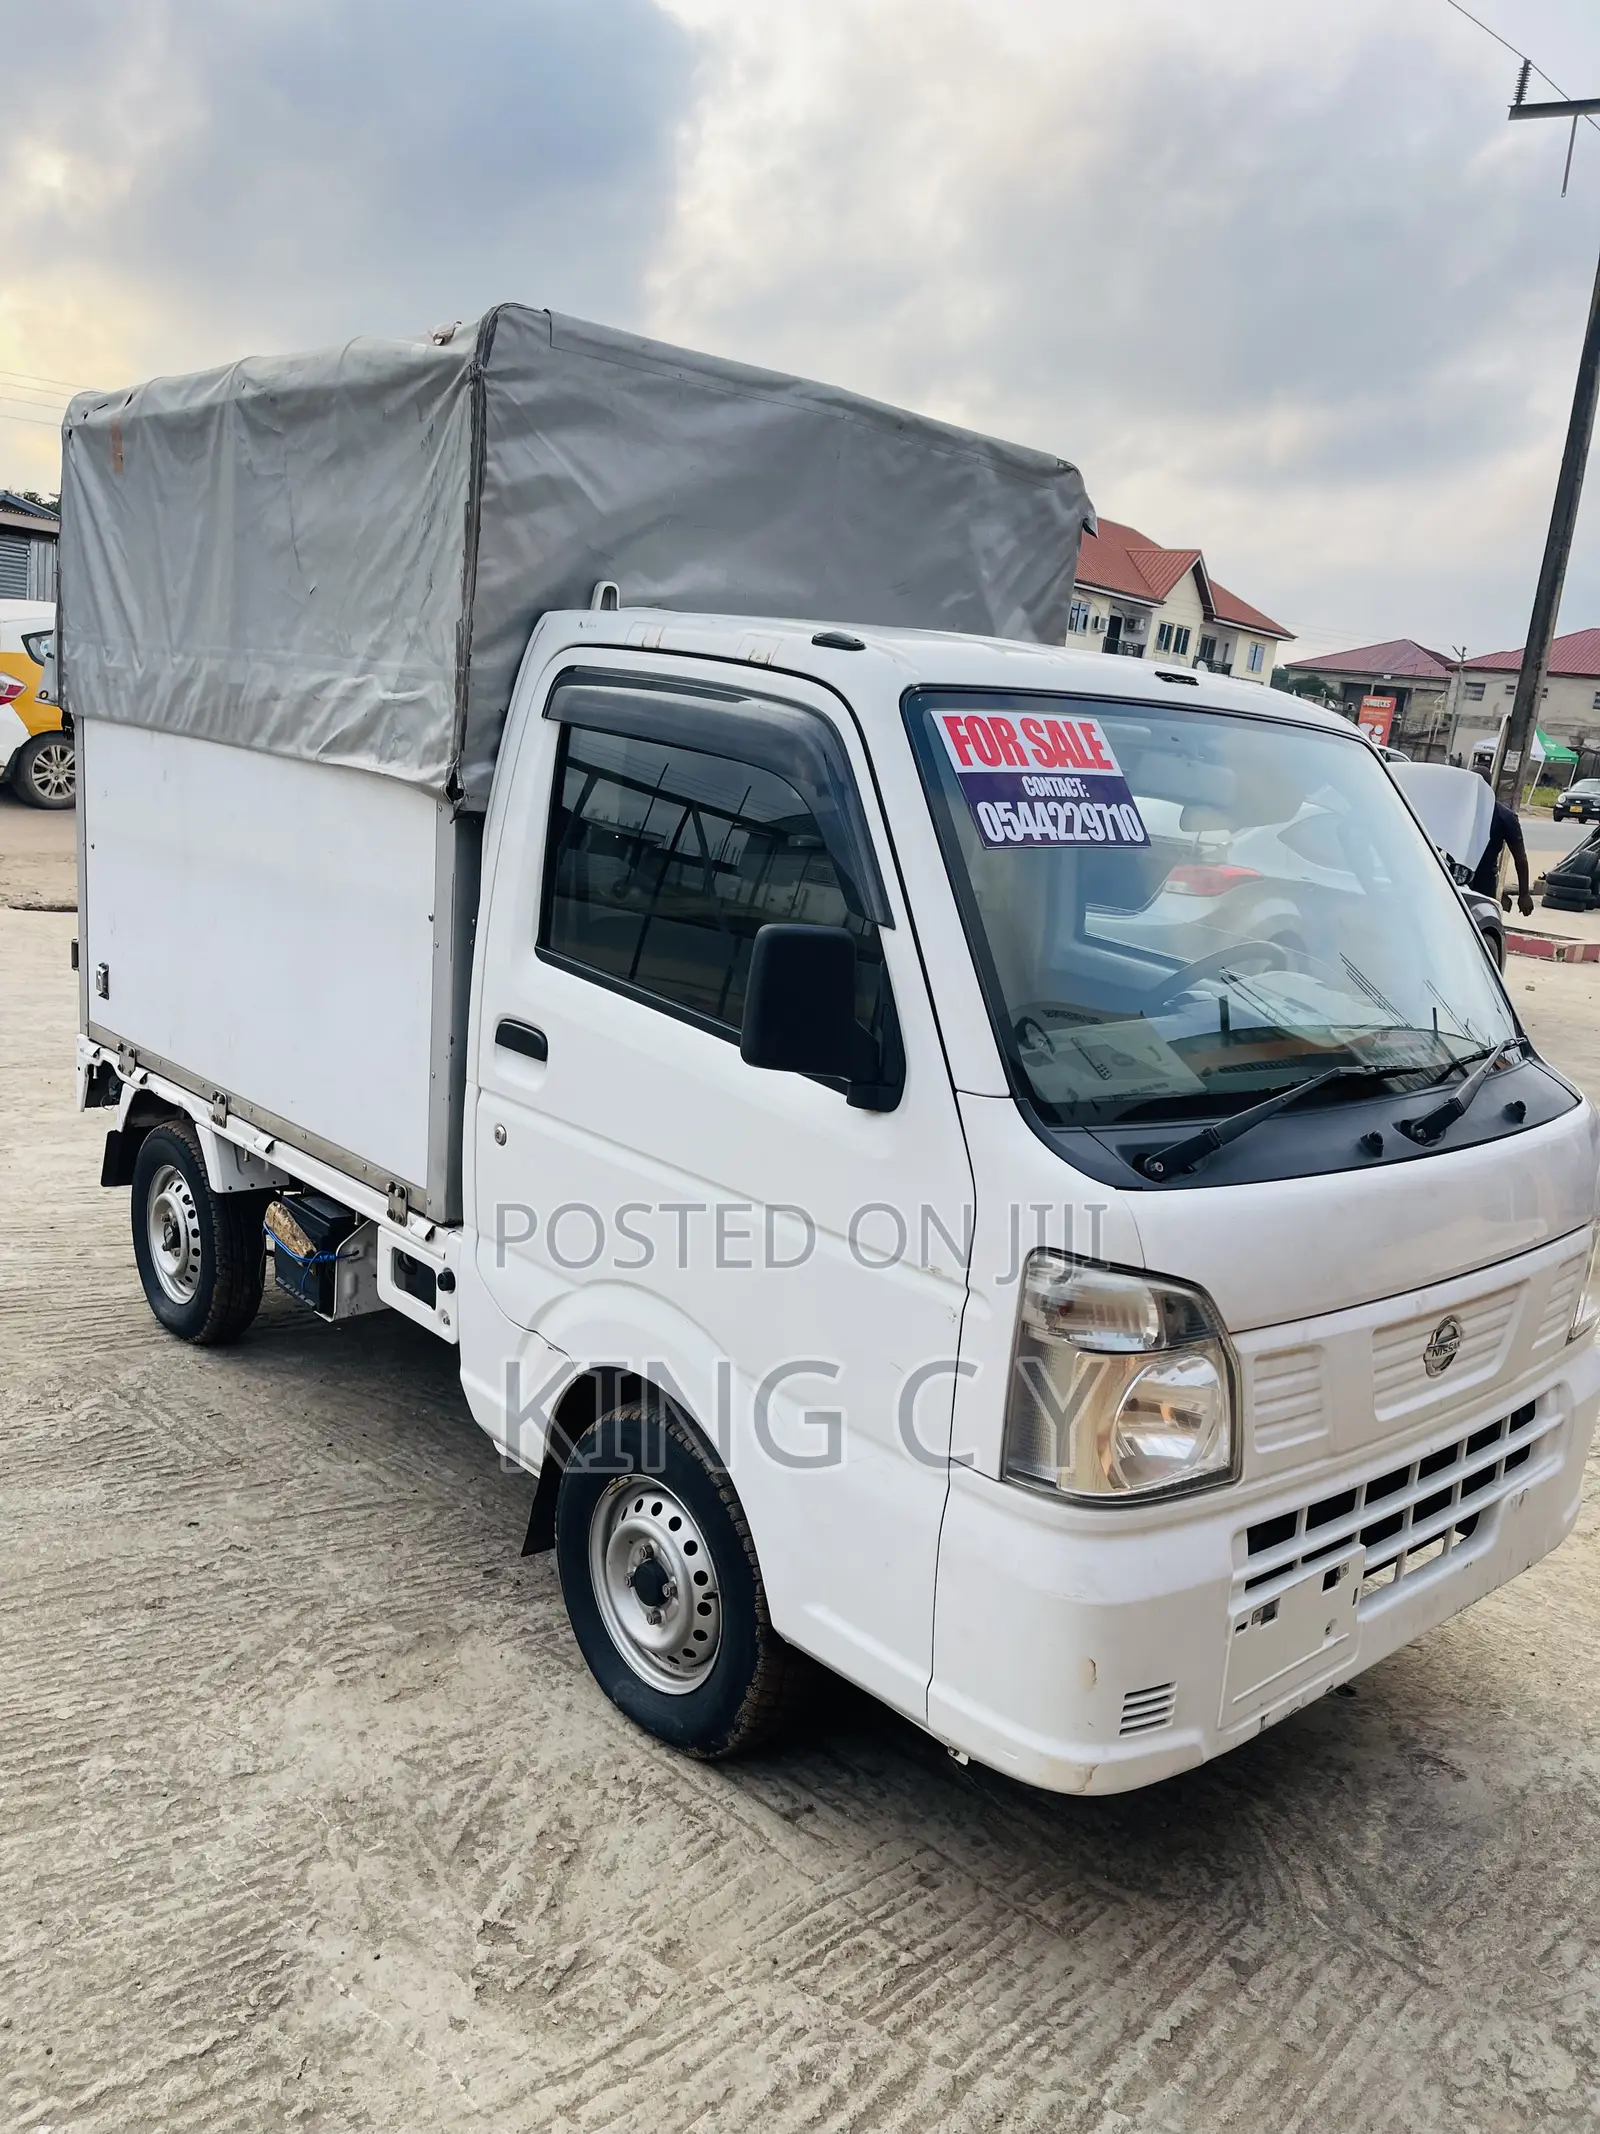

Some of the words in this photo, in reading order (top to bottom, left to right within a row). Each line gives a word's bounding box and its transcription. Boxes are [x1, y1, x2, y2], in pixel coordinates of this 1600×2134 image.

[942, 716, 1030, 767] FOR
[1019, 717, 1113, 770] SALE
[1022, 775, 1090, 798] CONTACT:
[977, 801, 1144, 842] 0544229710
